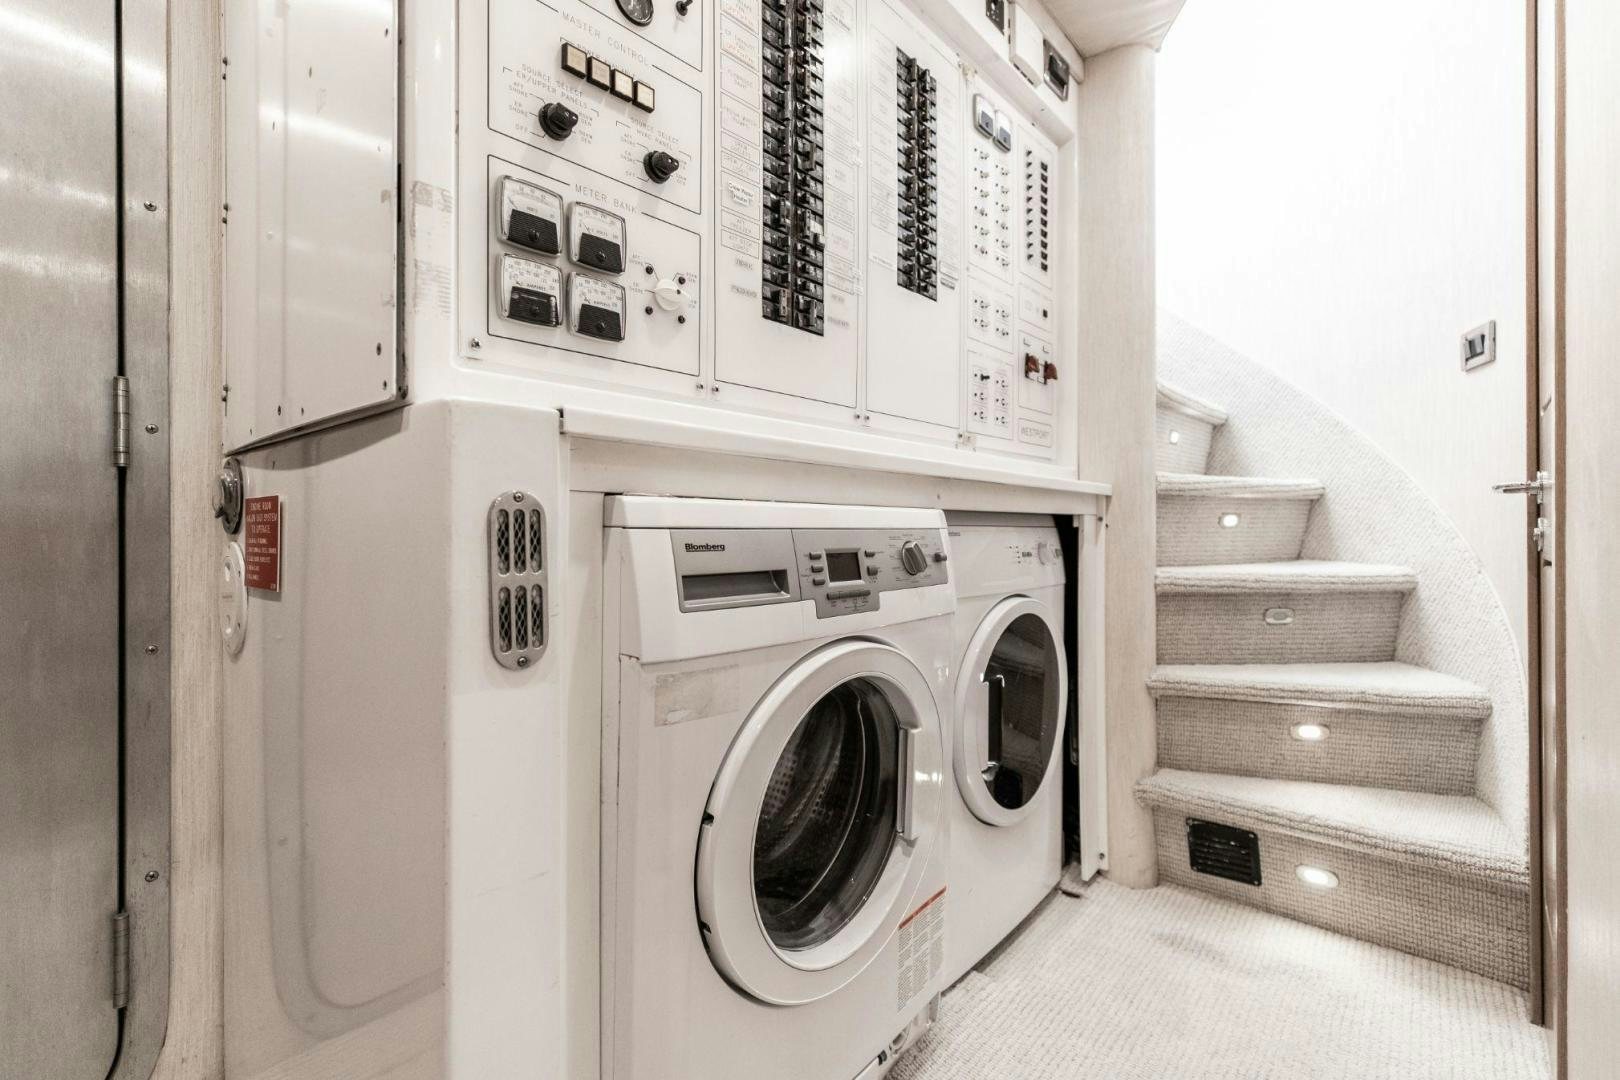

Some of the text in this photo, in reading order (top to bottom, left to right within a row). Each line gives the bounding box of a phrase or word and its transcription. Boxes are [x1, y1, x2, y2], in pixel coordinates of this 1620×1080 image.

[562, 10, 648, 66] MASTER CONTROL
[575, 184, 608, 202] METER
[613, 198, 637, 214] BANK
[685, 543, 725, 552] Blomberg
